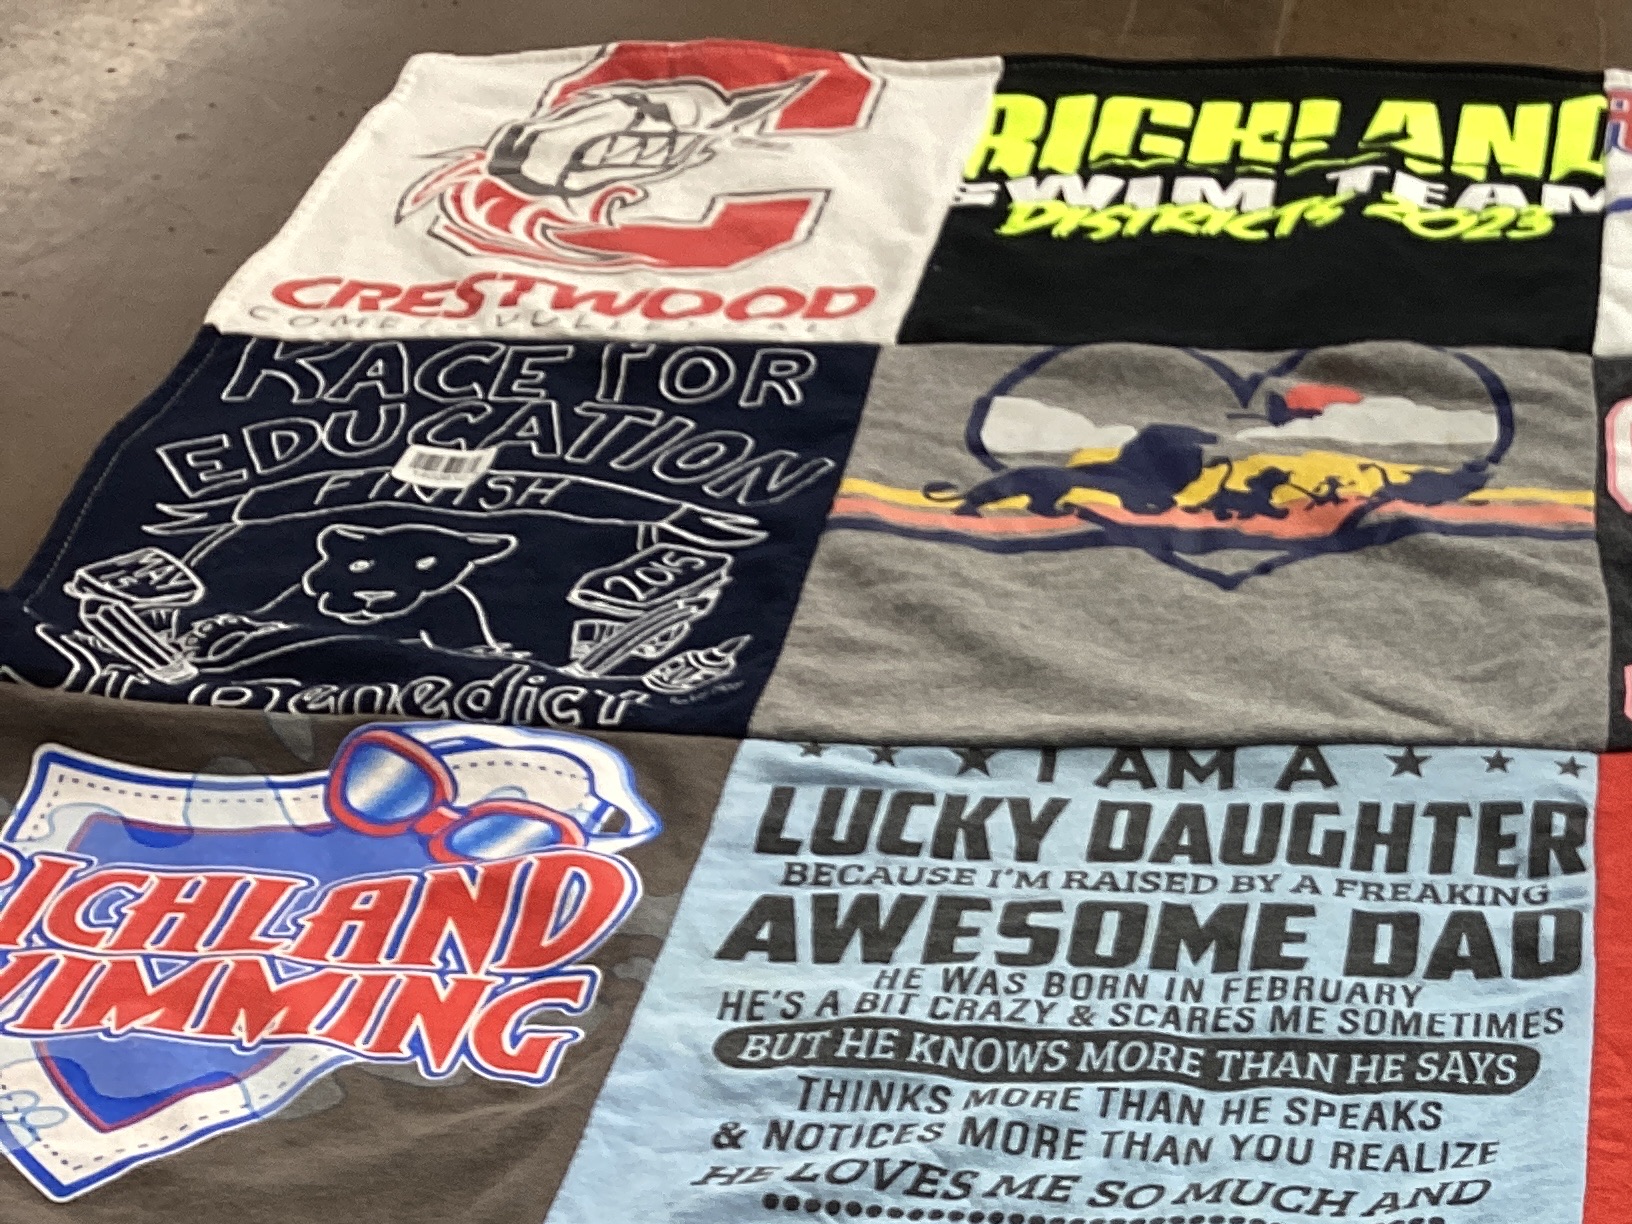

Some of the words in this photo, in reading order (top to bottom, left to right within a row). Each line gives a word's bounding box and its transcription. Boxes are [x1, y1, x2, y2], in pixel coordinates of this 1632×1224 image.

[1362, 191, 1555, 241] 2023
[271, 271, 878, 320] CRESTWOOD
[156, 401, 835, 505] EDUCATION
[603, 550, 707, 602] 2015
[1095, 747, 1237, 791] AM
[1274, 746, 1339, 791] A
[754, 785, 1072, 863] LUCKY
[1086, 798, 1588, 880] DAUGHTER
[780, 861, 976, 887] BECAUSE
[987, 867, 1052, 890] I'M
[1062, 869, 1219, 895] RAISED
[1228, 873, 1283, 895] BY
[1289, 875, 1323, 896] A
[1333, 878, 1552, 908] FREAKING
[714, 893, 1317, 972] AWESOME
[1343, 907, 1584, 981] DAD
[716, 989, 804, 1022] HE'S
[814, 990, 840, 1017] A
[853, 992, 920, 1016] BIT
[927, 995, 1058, 1025] CRAZY
[1067, 1003, 1097, 1028] &
[1108, 1002, 1256, 1034] SCARES
[1269, 1005, 1327, 1035] ME
[1337, 1008, 1565, 1040] SOMETIMES
[873, 966, 926, 991] HE
[942, 966, 1027, 997] WAS
[1043, 971, 1149, 1001] BORN
[1165, 975, 1206, 1002] IN
[1220, 975, 1424, 1009] FEBRUARY
[737, 1029, 832, 1062] BUT
[834, 1027, 900, 1060] HE
[906, 1034, 1069, 1075] KNOWS
[1076, 1040, 1205, 1078] MORE
[1216, 1049, 1338, 1084] THAN
[1345, 1054, 1405, 1085] HE
[1414, 1050, 1519, 1087] SAYS
[797, 1075, 953, 1116] THINKS
[962, 1086, 1084, 1112] MORE
[1096, 1087, 1204, 1126] THAN
[1219, 1096, 1273, 1127] HE
[1283, 1099, 1445, 1132] SPEAKS
[711, 1121, 748, 1150] &
[762, 1119, 947, 1152] NOTICES
[957, 1116, 1088, 1161] MORE
[1100, 1130, 1215, 1166] THAN
[1229, 1134, 1313, 1166] YOU
[1329, 1140, 1501, 1174] REALIZE
[690, 1165, 781, 1187] HE
[784, 1158, 980, 1201] LOVES
[982, 1174, 1082, 1202] ME
[1089, 1179, 1167, 1210] SO
[1171, 1177, 1361, 1217] MUCH
[1360, 1179, 1493, 1218] AND
